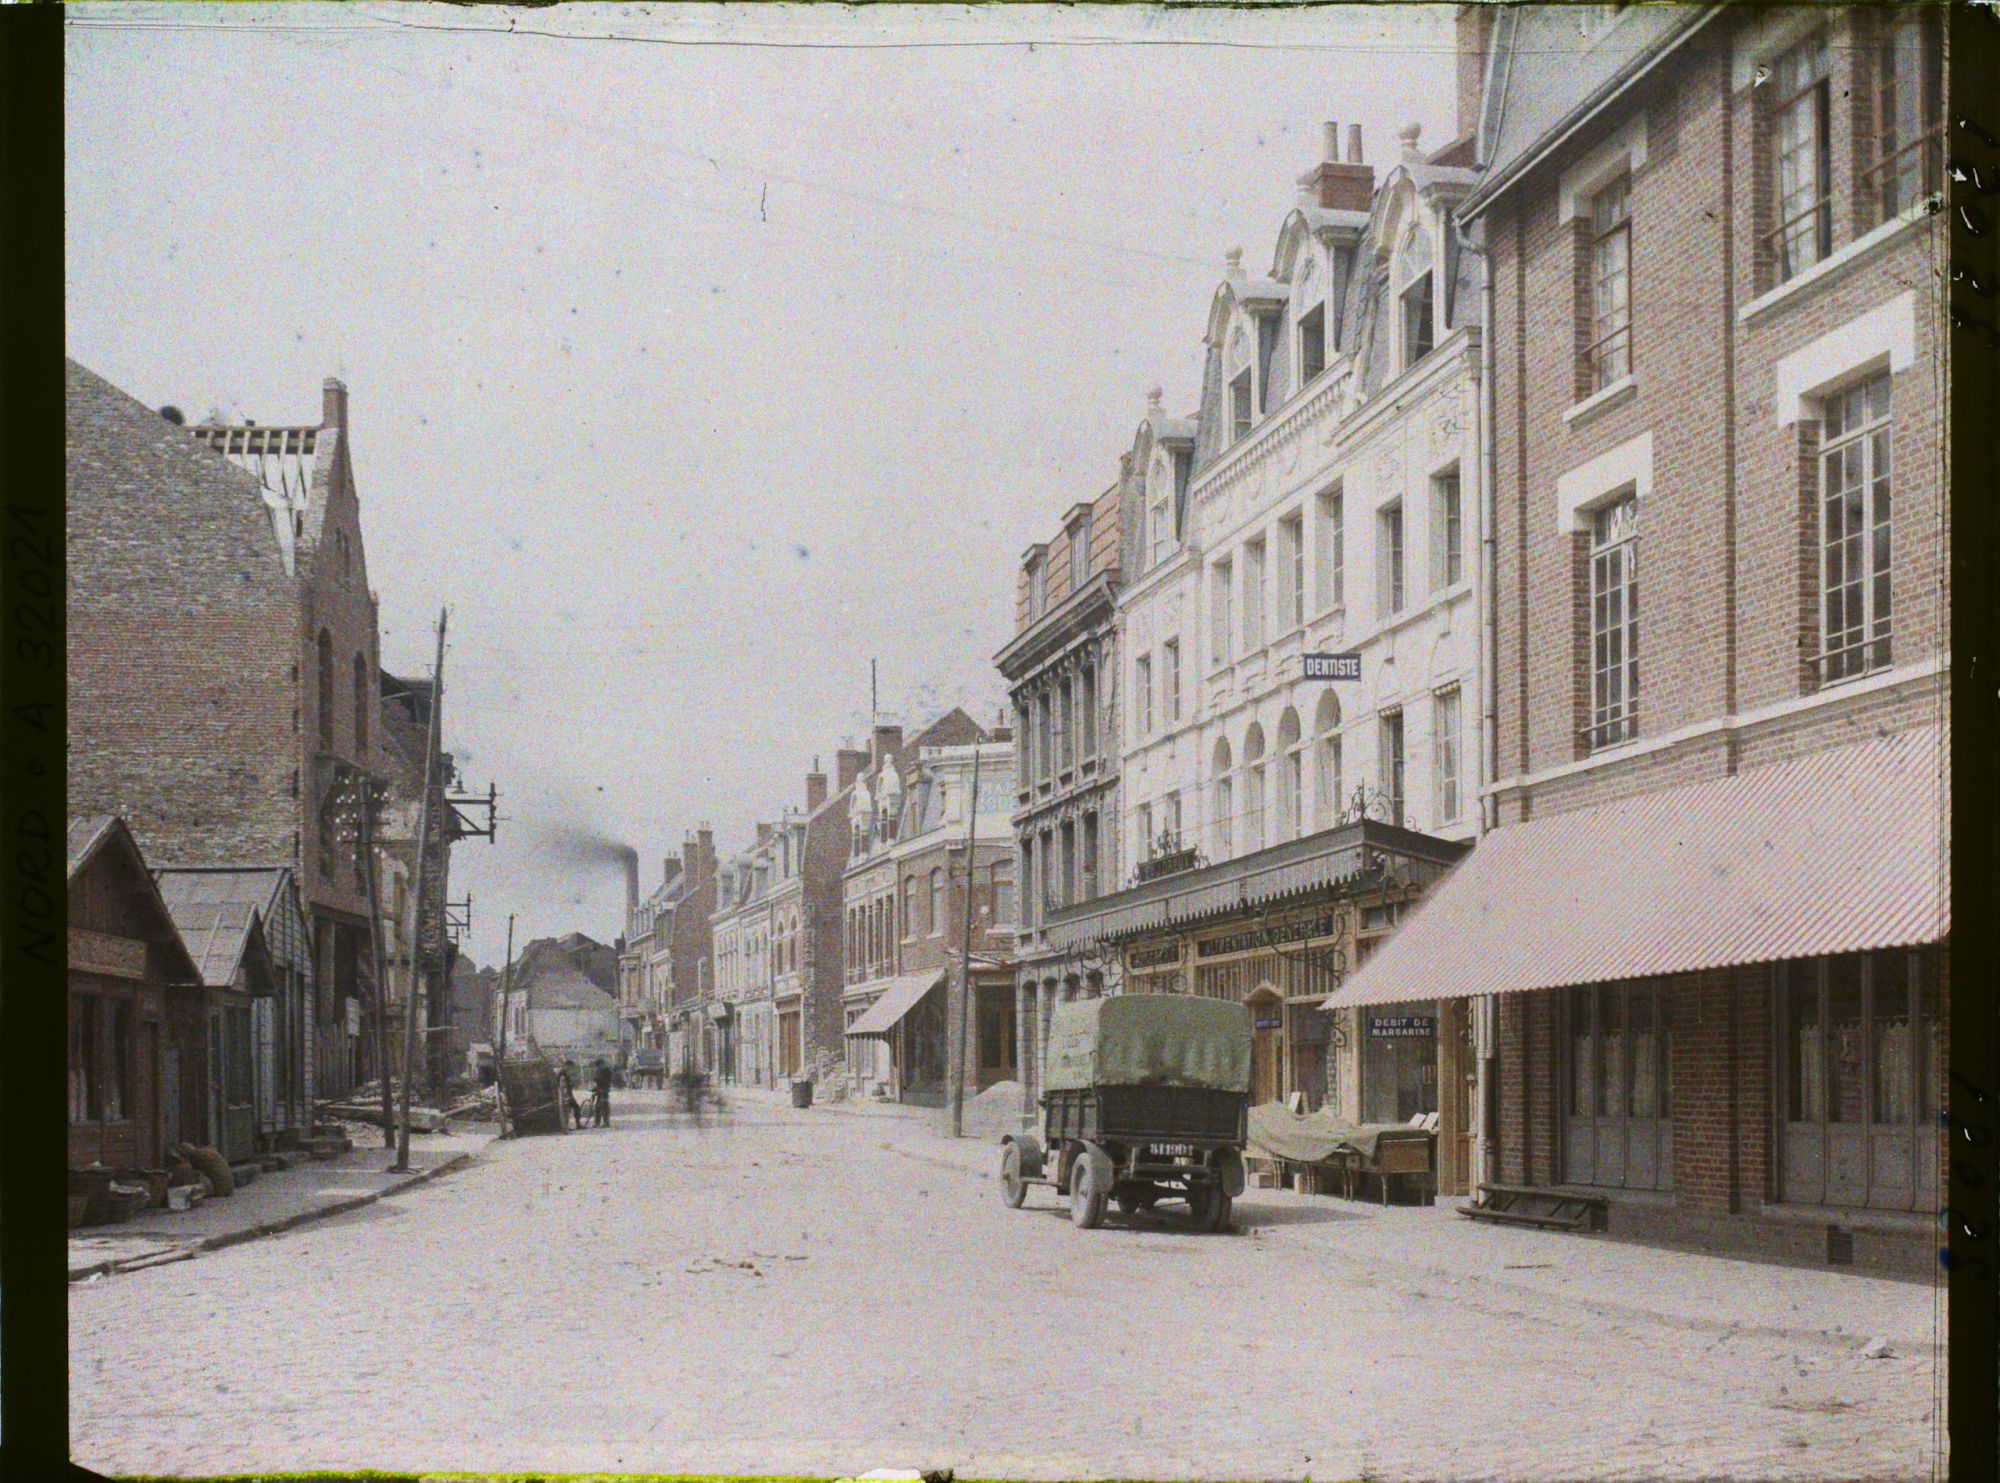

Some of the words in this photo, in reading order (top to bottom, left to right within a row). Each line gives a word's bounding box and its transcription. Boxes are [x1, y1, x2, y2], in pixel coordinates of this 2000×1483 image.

[7, 503, 55, 670] 32021
[1306, 658, 1359, 676] DENTISTE
[11, 702, 54, 731] A
[16, 809, 58, 967] NORD
[1372, 1028, 1431, 1036] MARGARINE
[1413, 1018, 1429, 1027] DE
